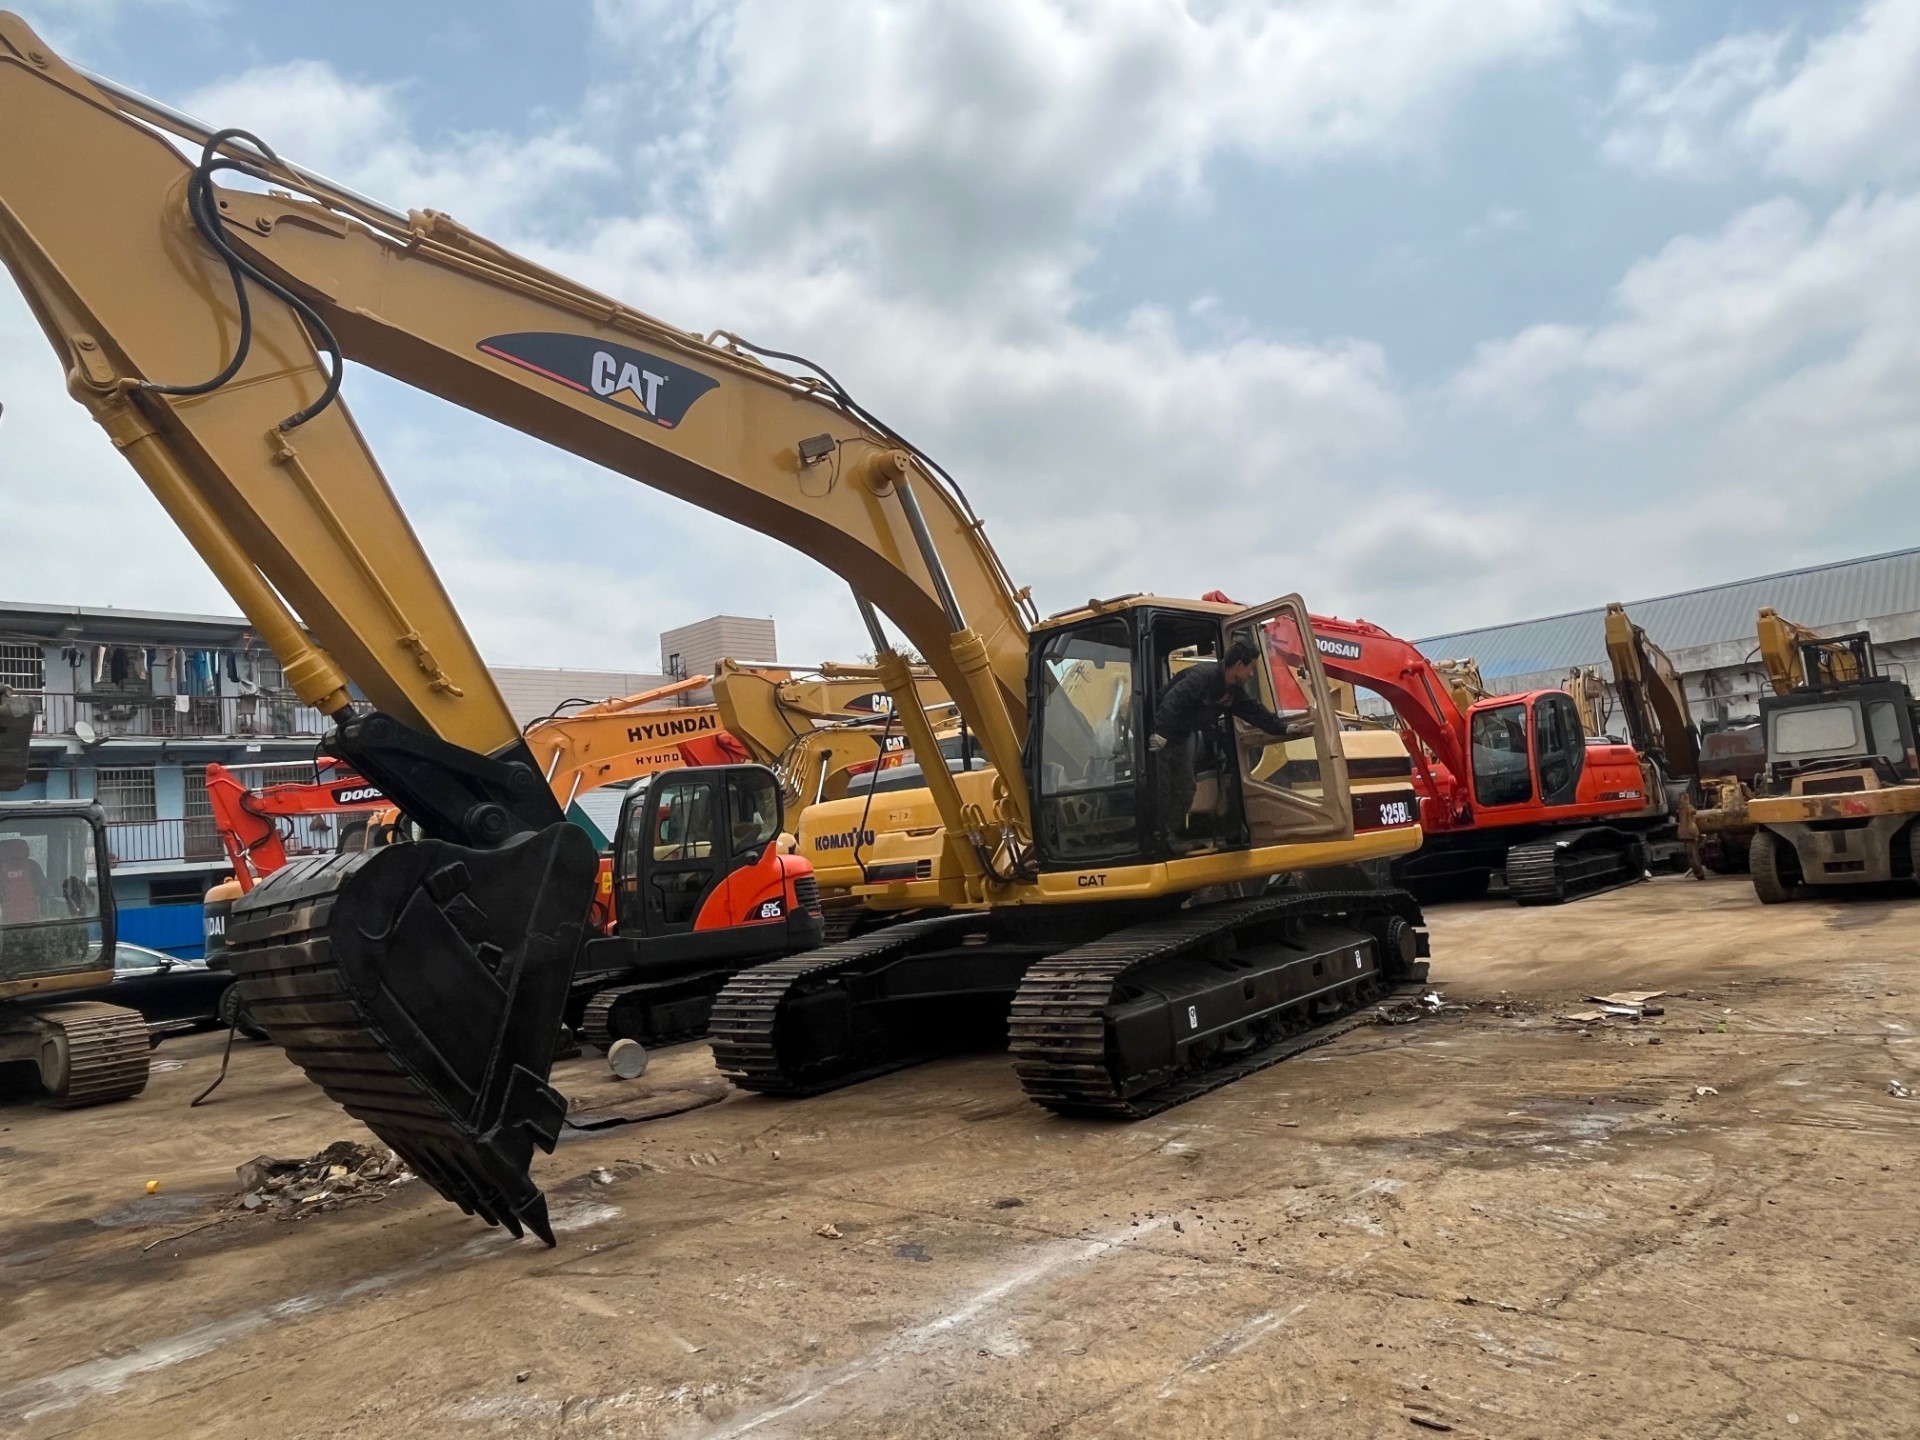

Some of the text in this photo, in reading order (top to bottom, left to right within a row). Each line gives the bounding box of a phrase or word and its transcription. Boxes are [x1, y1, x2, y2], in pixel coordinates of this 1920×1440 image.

[591, 351, 664, 416] CAT
[872, 694, 893, 713] CAT
[627, 715, 716, 742] HYUNDAI
[886, 736, 905, 751] CAT
[815, 827, 875, 851] KOMATSU
[1078, 875, 1107, 887] CAT
[762, 908, 781, 918] 60
